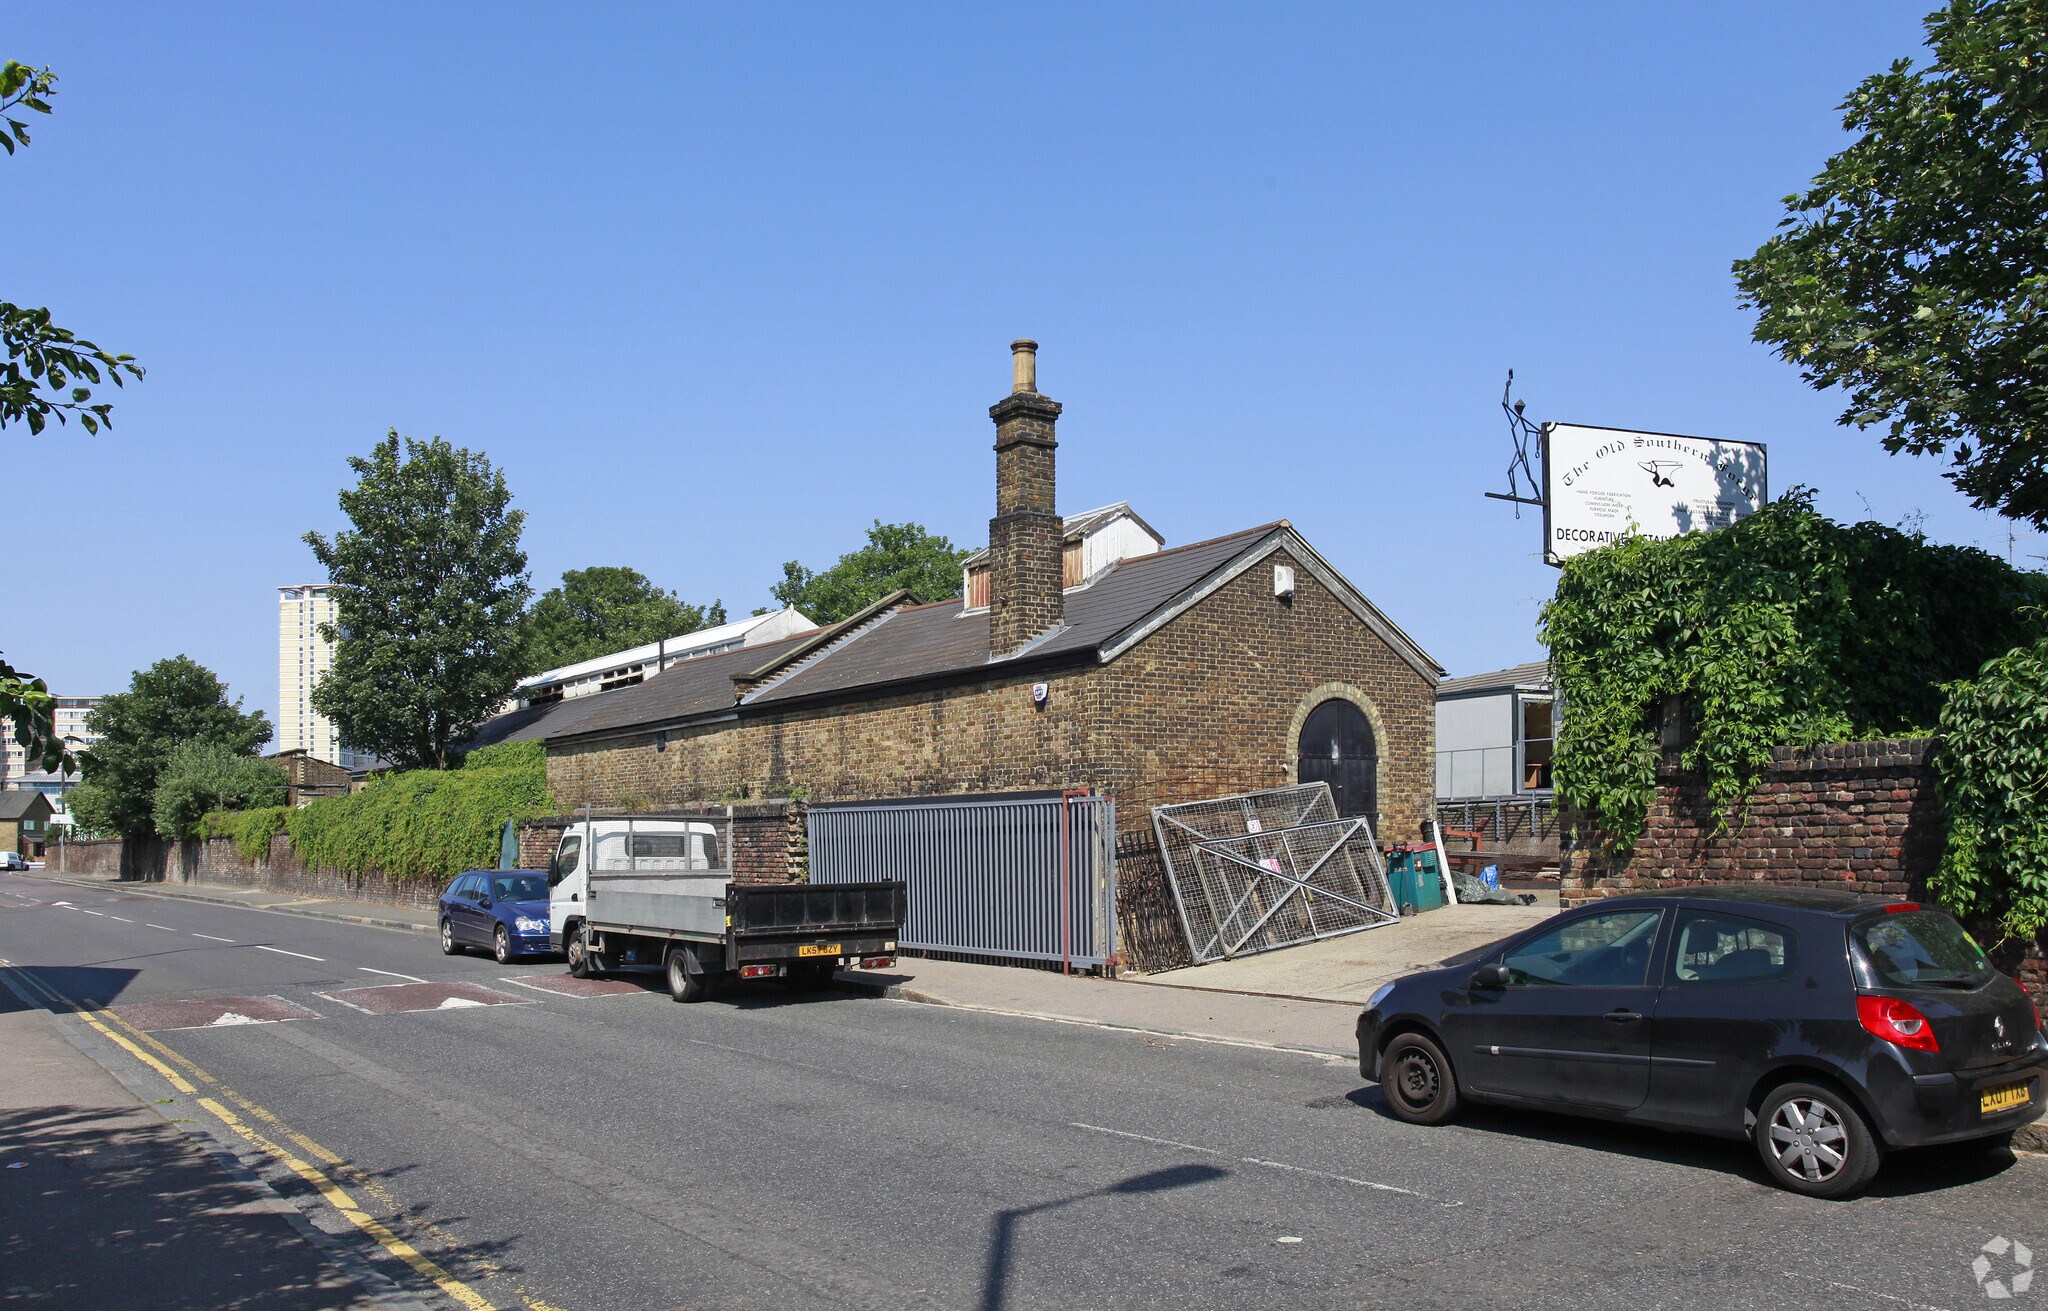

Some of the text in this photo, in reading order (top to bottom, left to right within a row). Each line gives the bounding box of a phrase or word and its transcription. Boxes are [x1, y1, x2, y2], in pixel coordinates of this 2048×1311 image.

[1562, 462, 1589, 486] The
[1596, 440, 1625, 459] Old
[1634, 436, 1708, 462] Southern
[1556, 528, 1626, 544] DECORATIVE
